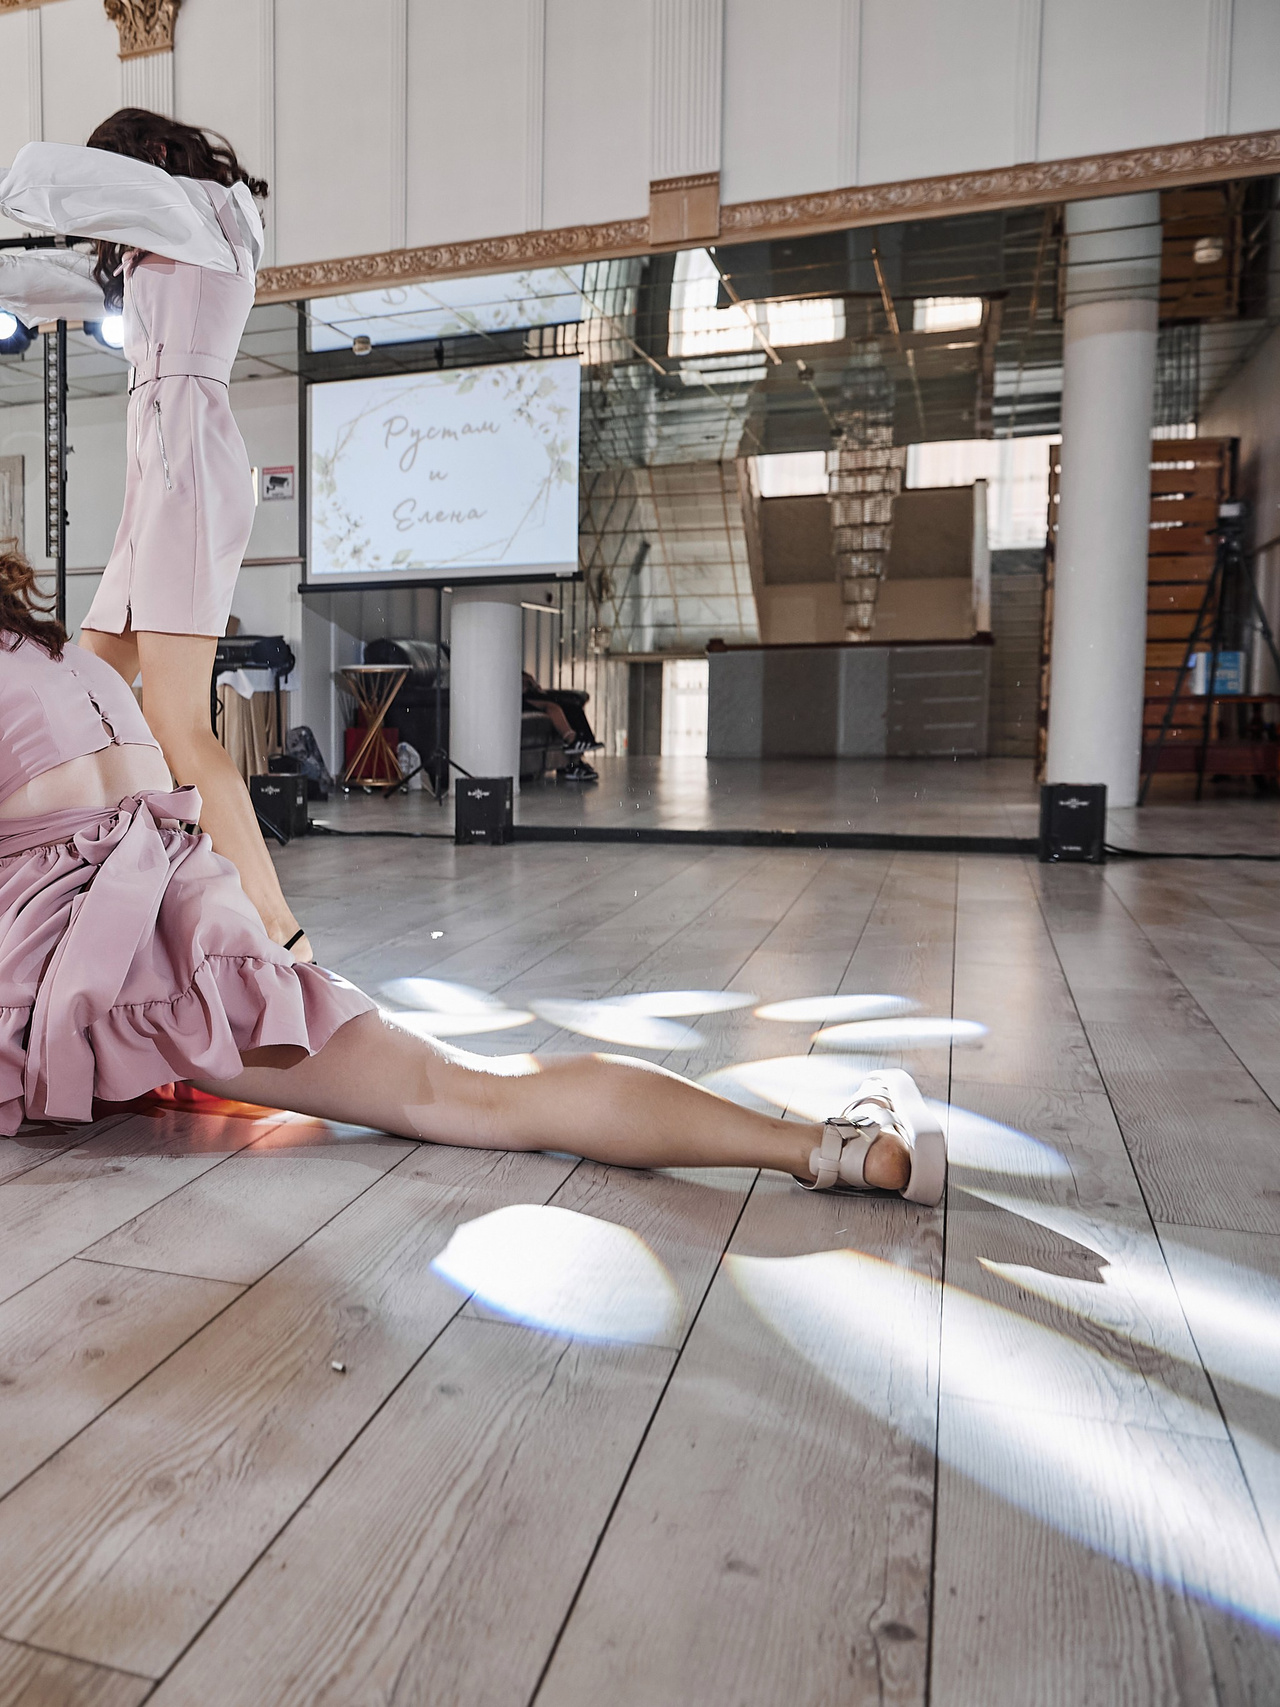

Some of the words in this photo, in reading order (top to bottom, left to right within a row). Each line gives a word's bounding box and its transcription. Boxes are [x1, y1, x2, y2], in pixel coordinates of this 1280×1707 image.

[383, 415, 501, 472] Рустам
[429, 470, 448, 481] и
[392, 498, 488, 532] Елена
